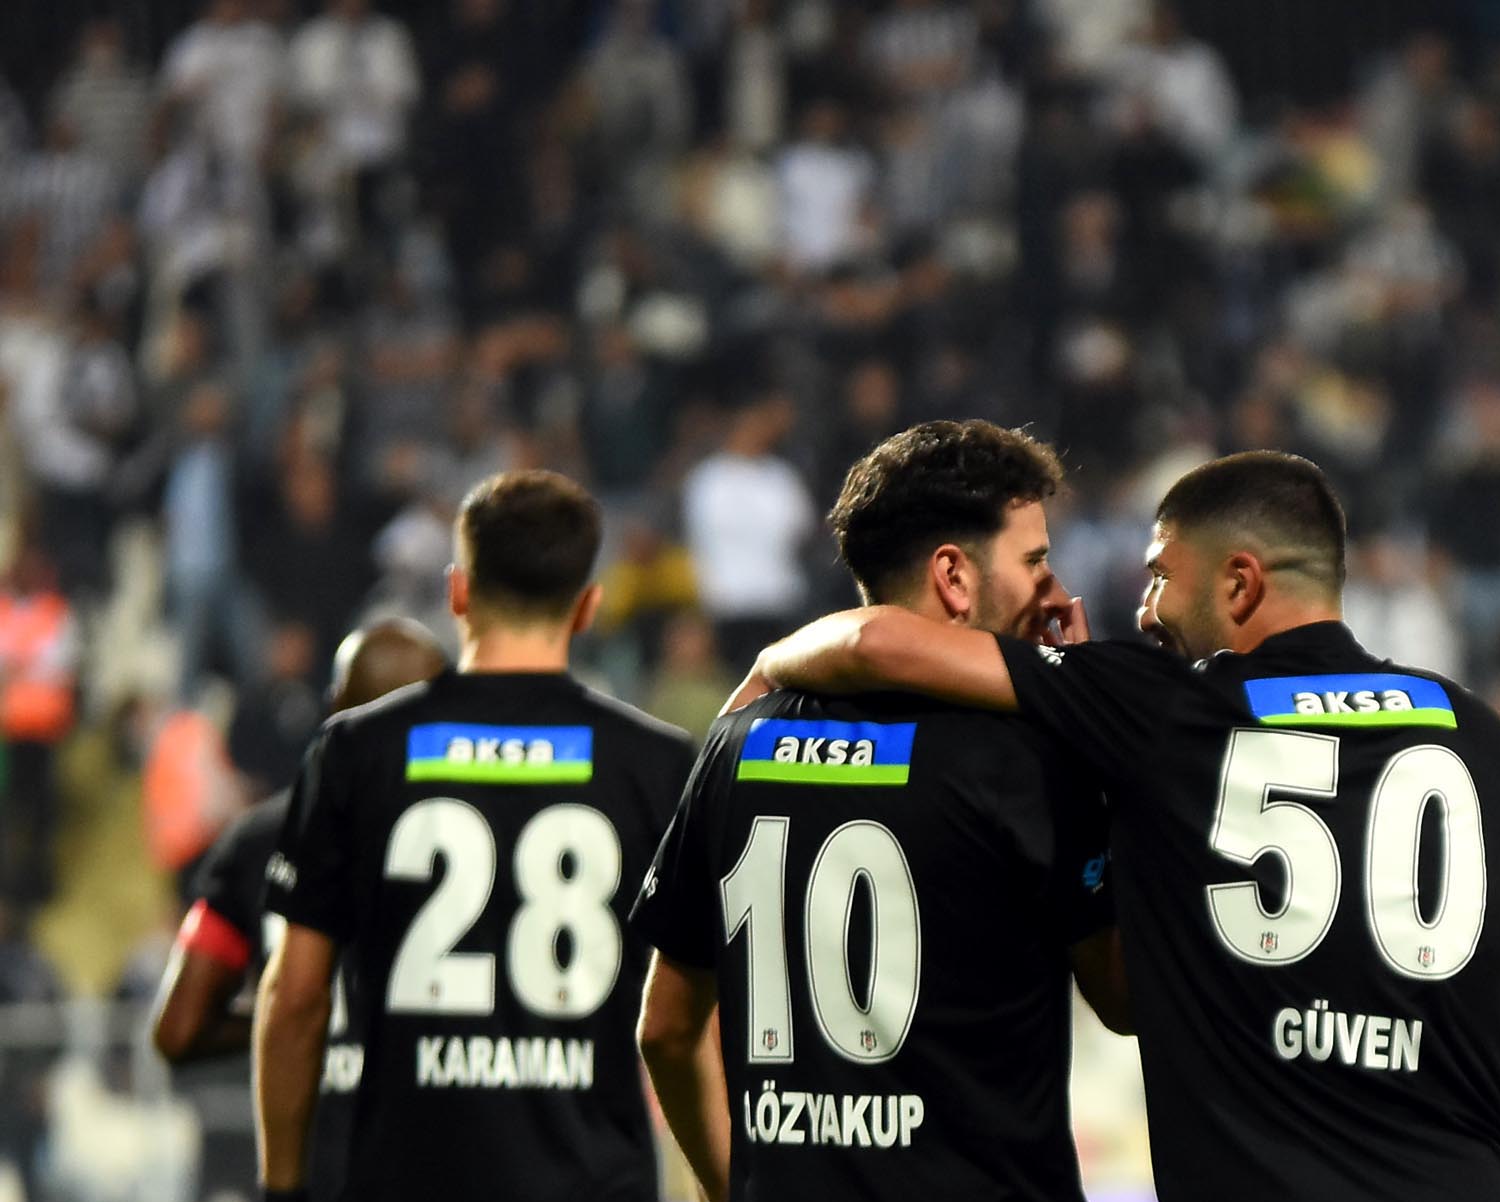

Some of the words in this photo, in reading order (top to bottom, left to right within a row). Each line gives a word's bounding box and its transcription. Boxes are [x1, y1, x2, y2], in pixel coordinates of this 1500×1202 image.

[1294, 688, 1415, 715] aksa
[444, 735, 555, 764] aksa
[773, 736, 874, 766] aksa
[1206, 727, 1488, 981] 50
[384, 797, 622, 1018] 28
[720, 815, 921, 1065] 10
[416, 1035, 594, 1090] KARAMAN
[1273, 999, 1423, 1072] GÜVEN
